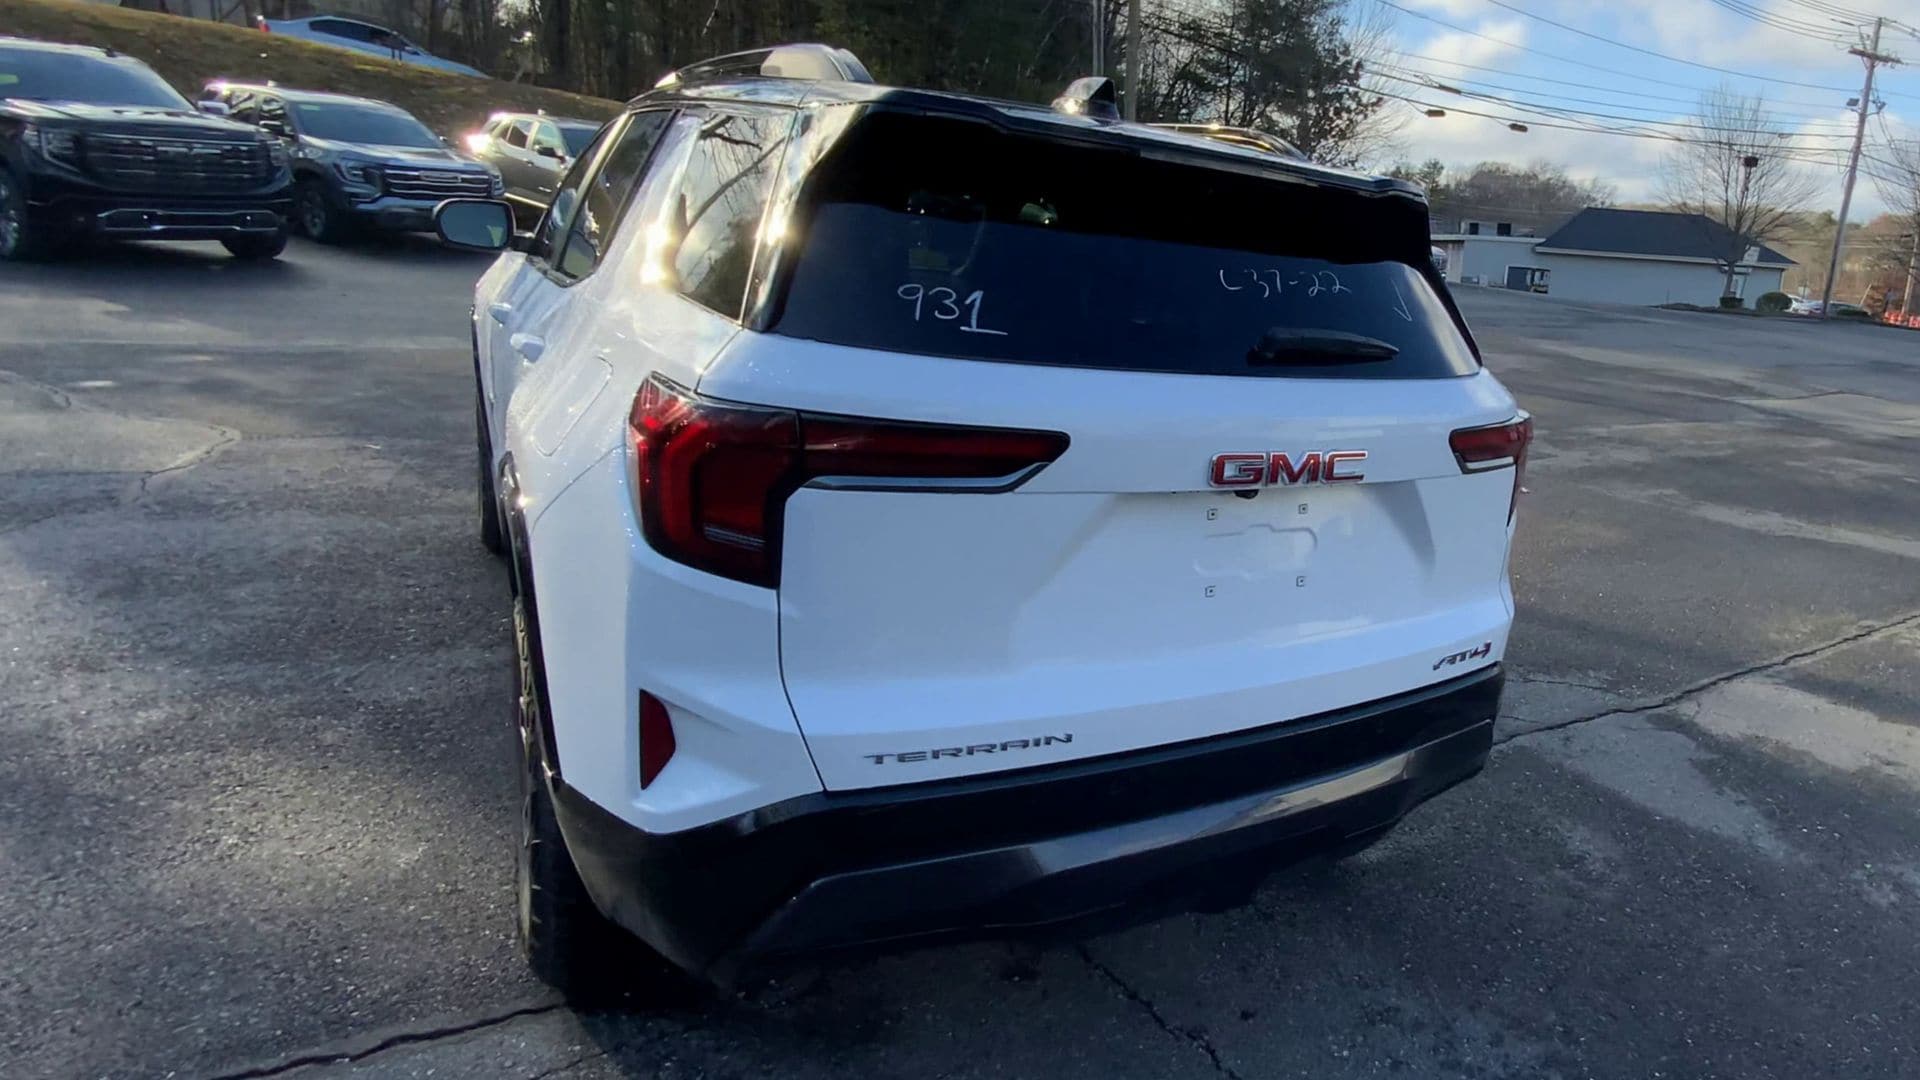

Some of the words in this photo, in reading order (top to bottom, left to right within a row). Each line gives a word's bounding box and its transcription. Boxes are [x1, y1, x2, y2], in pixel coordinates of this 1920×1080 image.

[897, 283, 1008, 335] 931
[1209, 450, 1368, 487] GMC
[1433, 641, 1492, 671] AT4
[863, 733, 1073, 765] TERRAIN
